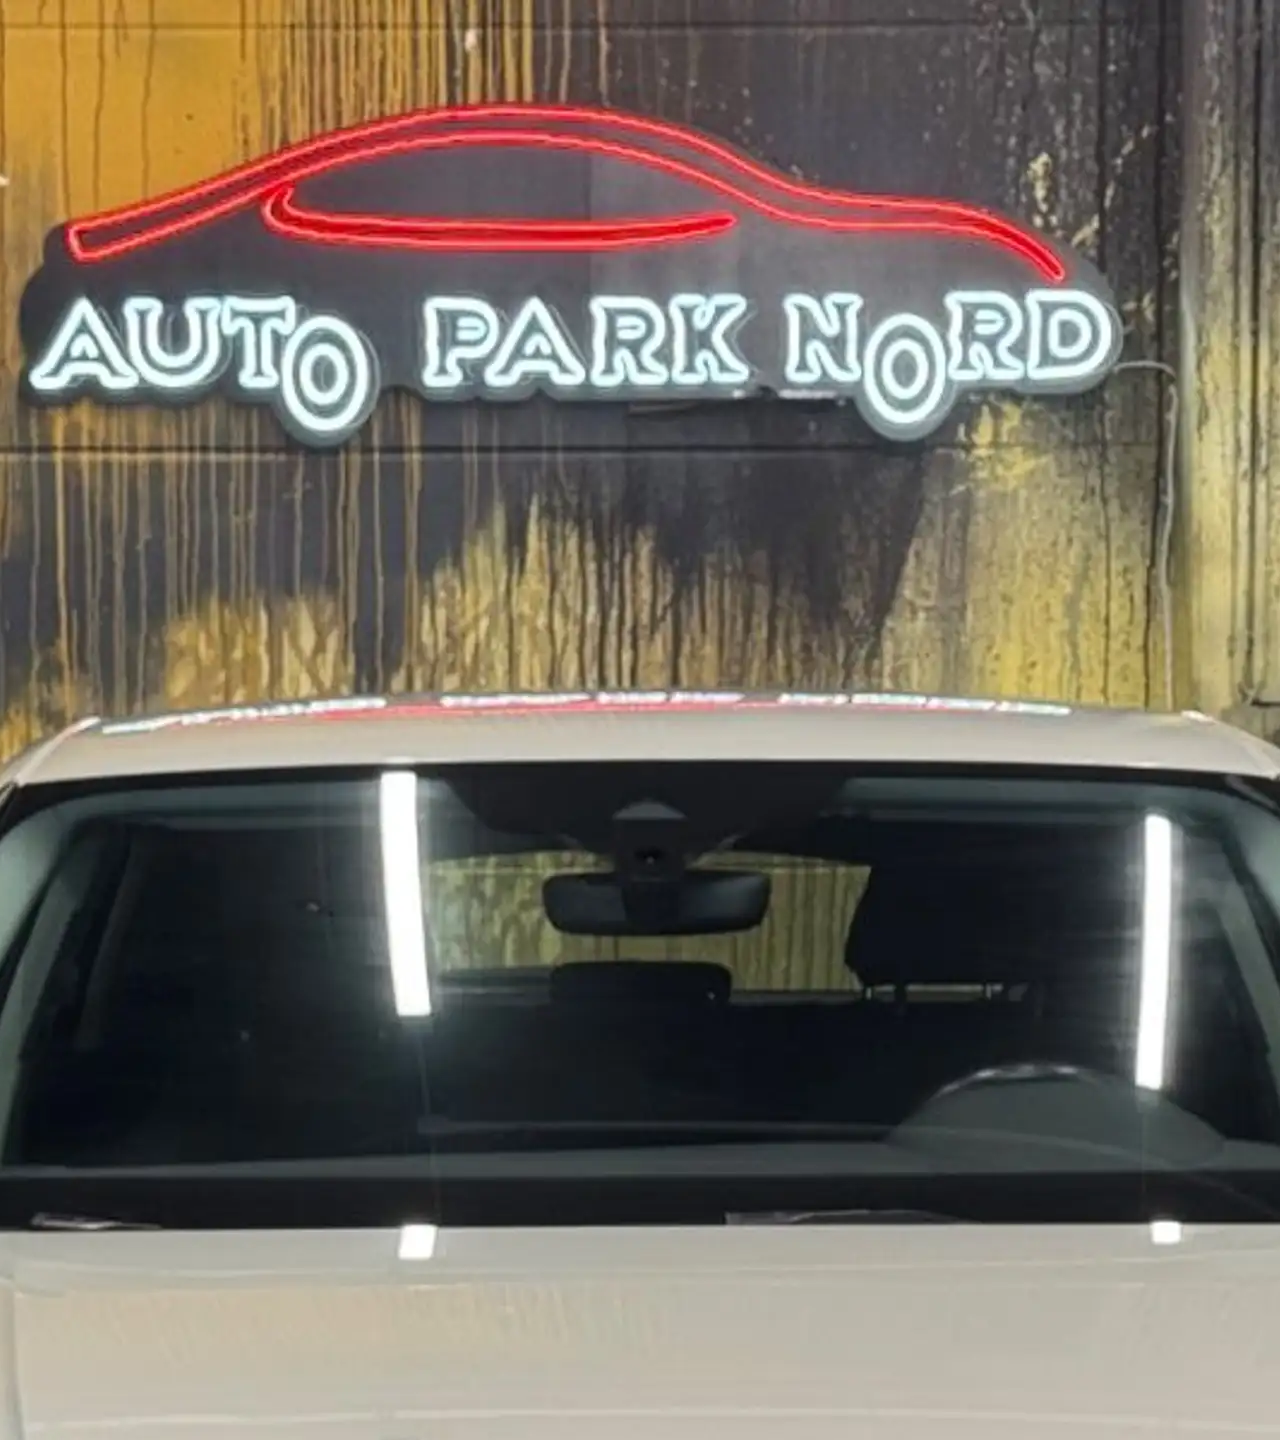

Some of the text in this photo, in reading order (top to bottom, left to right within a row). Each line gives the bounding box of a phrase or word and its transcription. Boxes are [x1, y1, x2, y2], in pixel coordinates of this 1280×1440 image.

[29, 289, 1116, 432] AUTO PARK NORD
